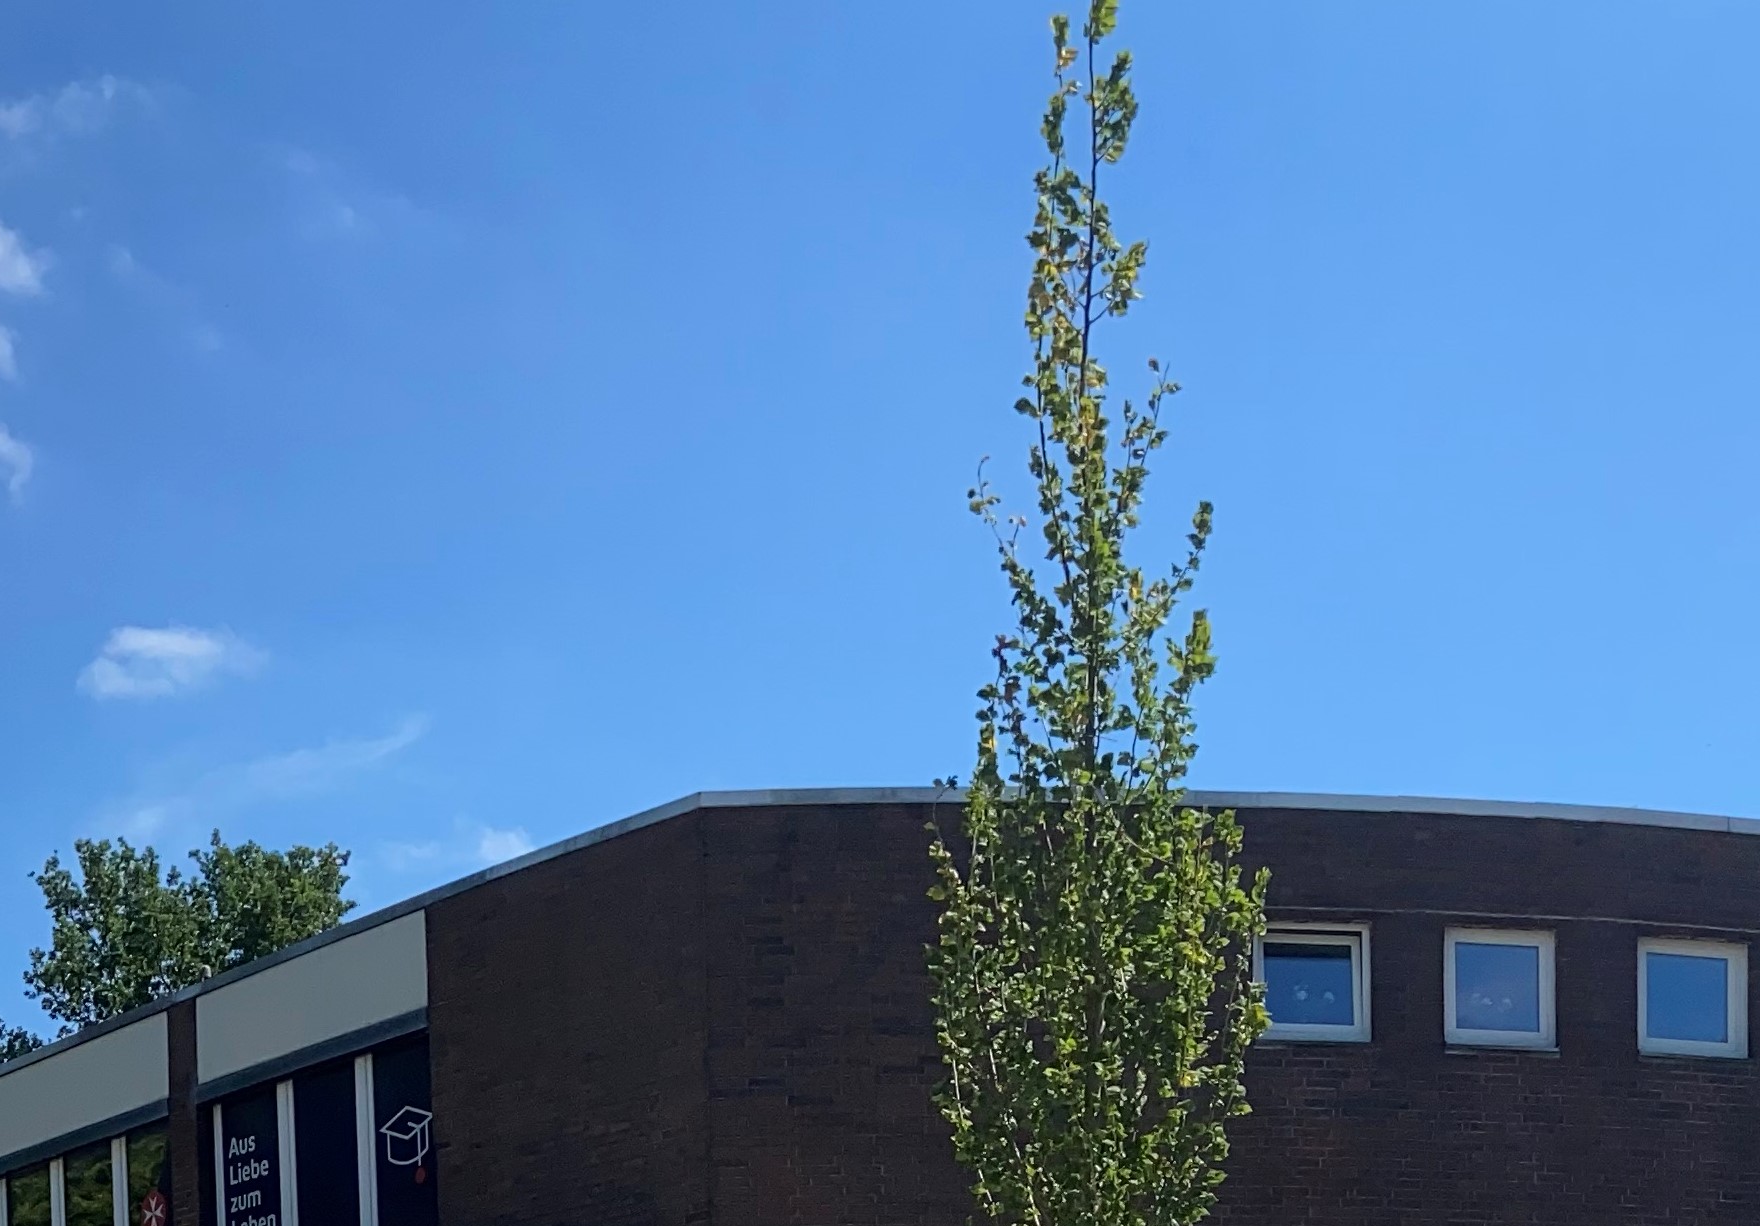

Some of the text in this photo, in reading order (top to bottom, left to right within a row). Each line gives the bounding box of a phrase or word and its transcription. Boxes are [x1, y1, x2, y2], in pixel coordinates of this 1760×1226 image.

[229, 1136, 256, 1159] Aus
[230, 1158, 269, 1185] Liebe
[230, 1190, 261, 1213] zum
